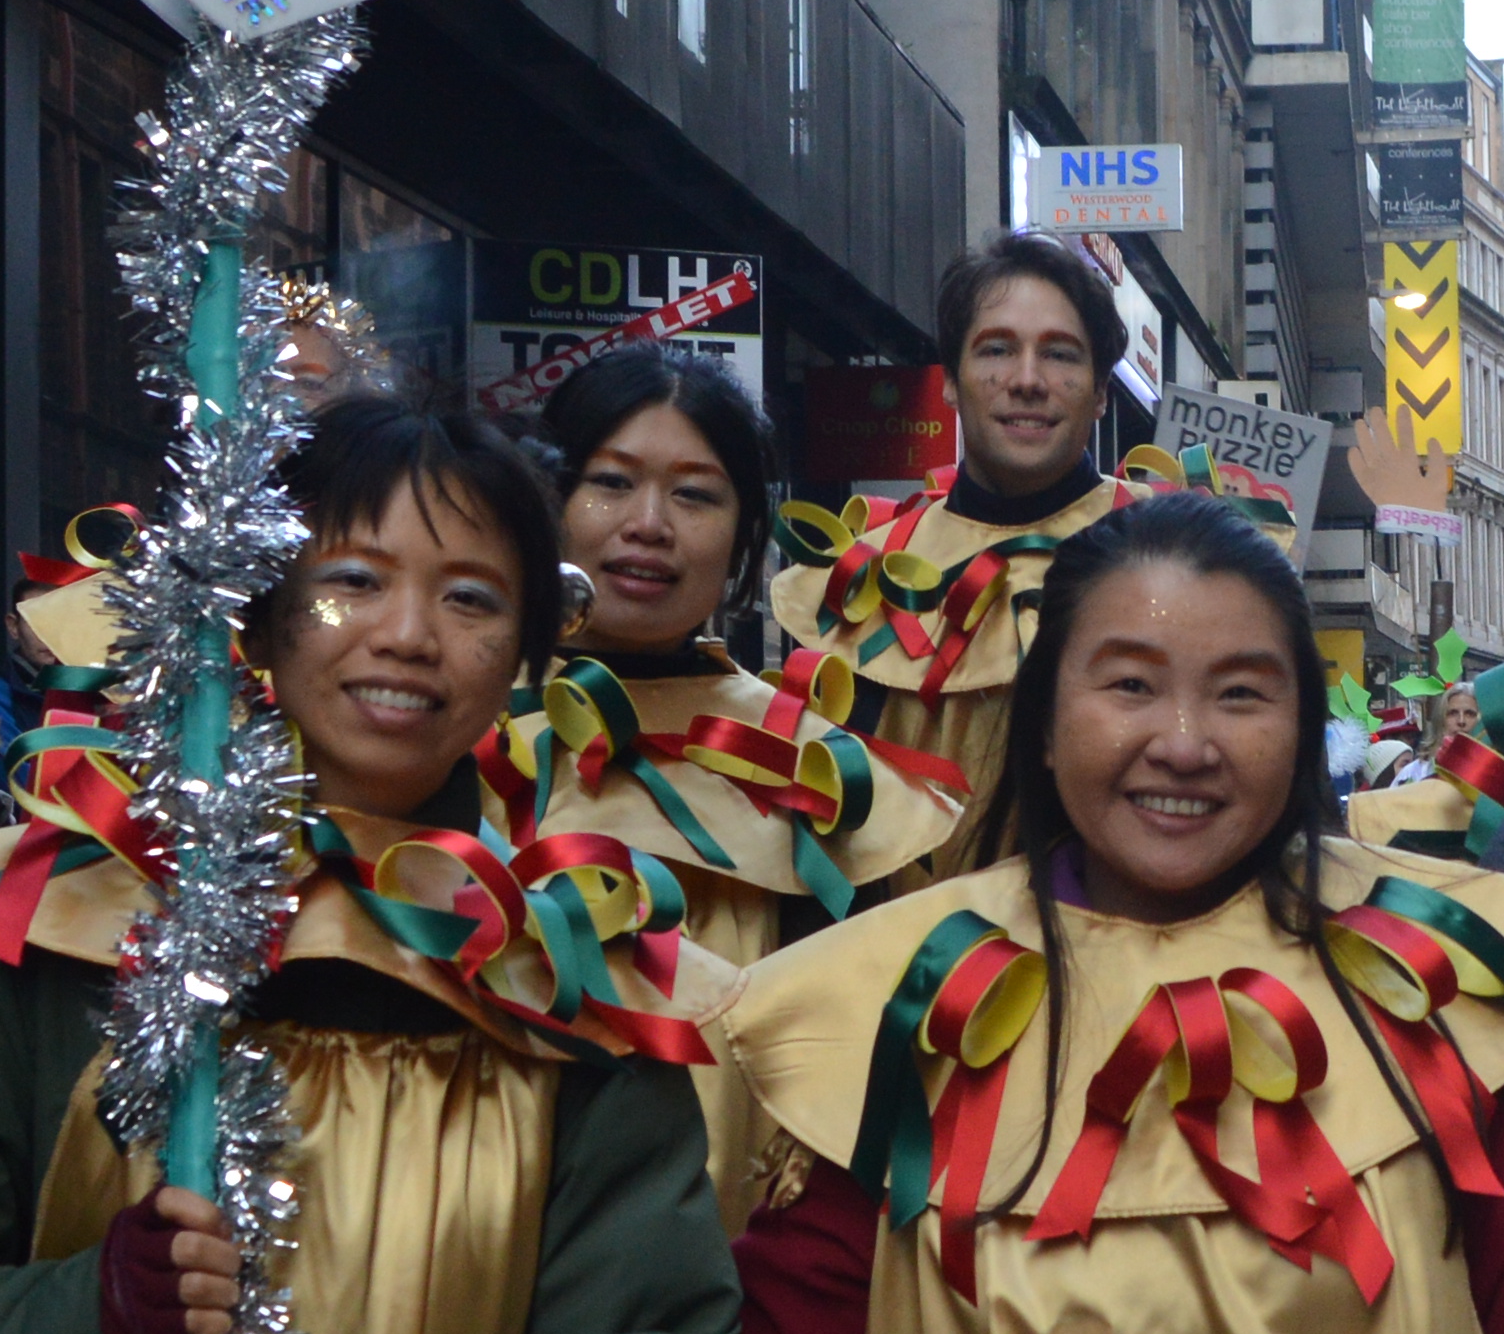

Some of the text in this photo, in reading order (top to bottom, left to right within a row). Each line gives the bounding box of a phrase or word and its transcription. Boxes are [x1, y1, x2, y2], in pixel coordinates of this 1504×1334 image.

[1382, 22, 1412, 35] shop
[1383, 38, 1457, 49] conferences
[1388, 148, 1453, 158] conferences
[1060, 150, 1160, 186] NHS
[1054, 207, 1168, 223] DENTAL
[528, 248, 708, 307] CDLH
[529, 307, 573, 320] Leisure
[575, 310, 584, 320] &
[648, 279, 736, 338] LET
[821, 417, 943, 439] Chop Chop
[1170, 395, 1316, 460] monkey
[1176, 427, 1296, 478] puzzle
